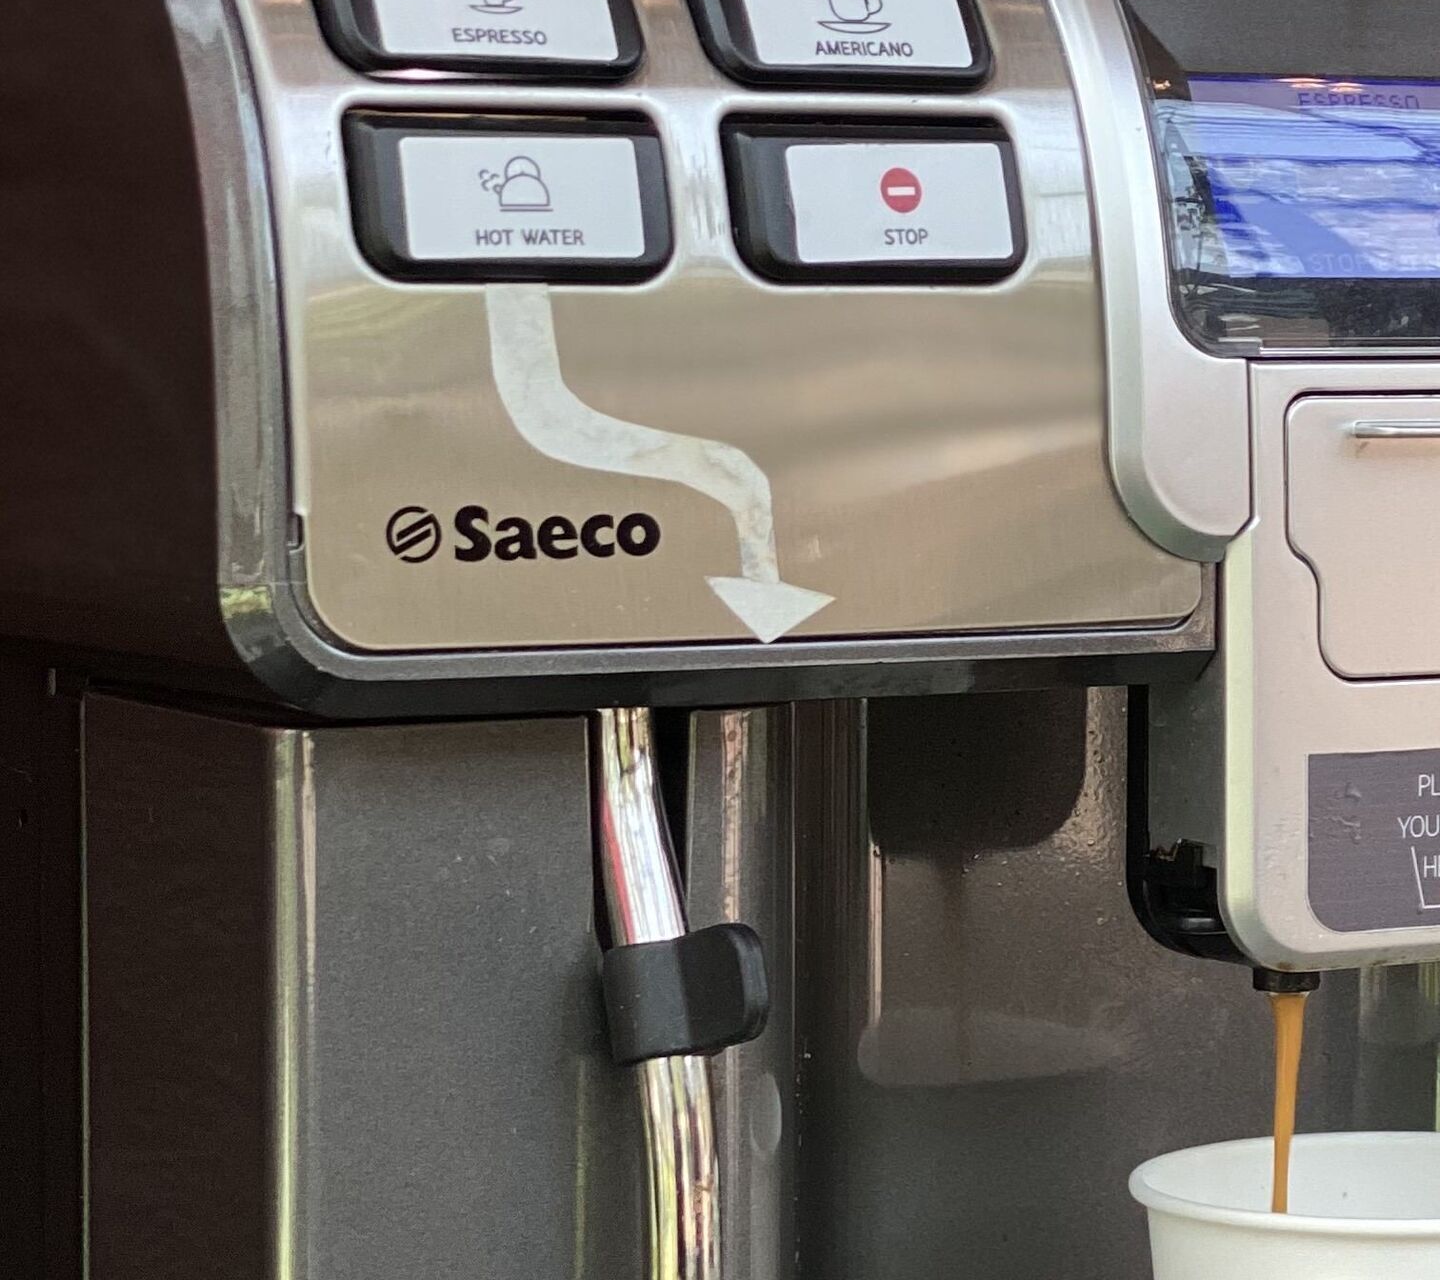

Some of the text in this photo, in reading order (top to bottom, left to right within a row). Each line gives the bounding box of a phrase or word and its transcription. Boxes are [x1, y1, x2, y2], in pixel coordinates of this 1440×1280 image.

[451, 26, 548, 47] ESPRESSO
[814, 40, 915, 58] AMERICANO
[475, 229, 585, 247] HOT WATER
[884, 228, 930, 247] STOP
[454, 505, 661, 562] Saeco
